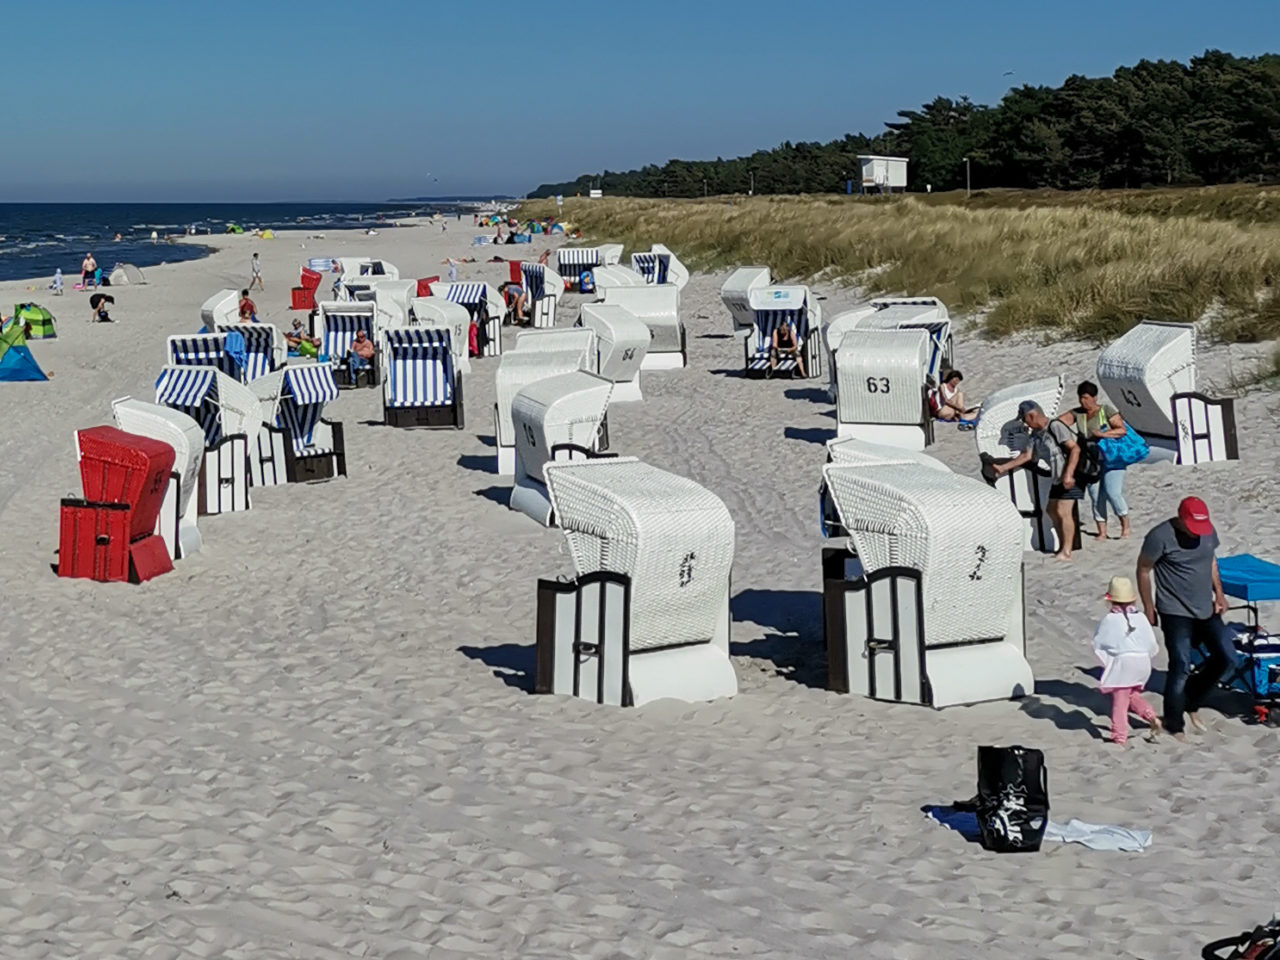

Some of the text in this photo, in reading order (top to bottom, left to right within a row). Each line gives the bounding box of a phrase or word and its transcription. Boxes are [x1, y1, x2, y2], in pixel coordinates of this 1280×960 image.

[866, 376, 890, 393] 63
[1120, 388, 1141, 407] 43
[969, 545, 986, 581] 2
